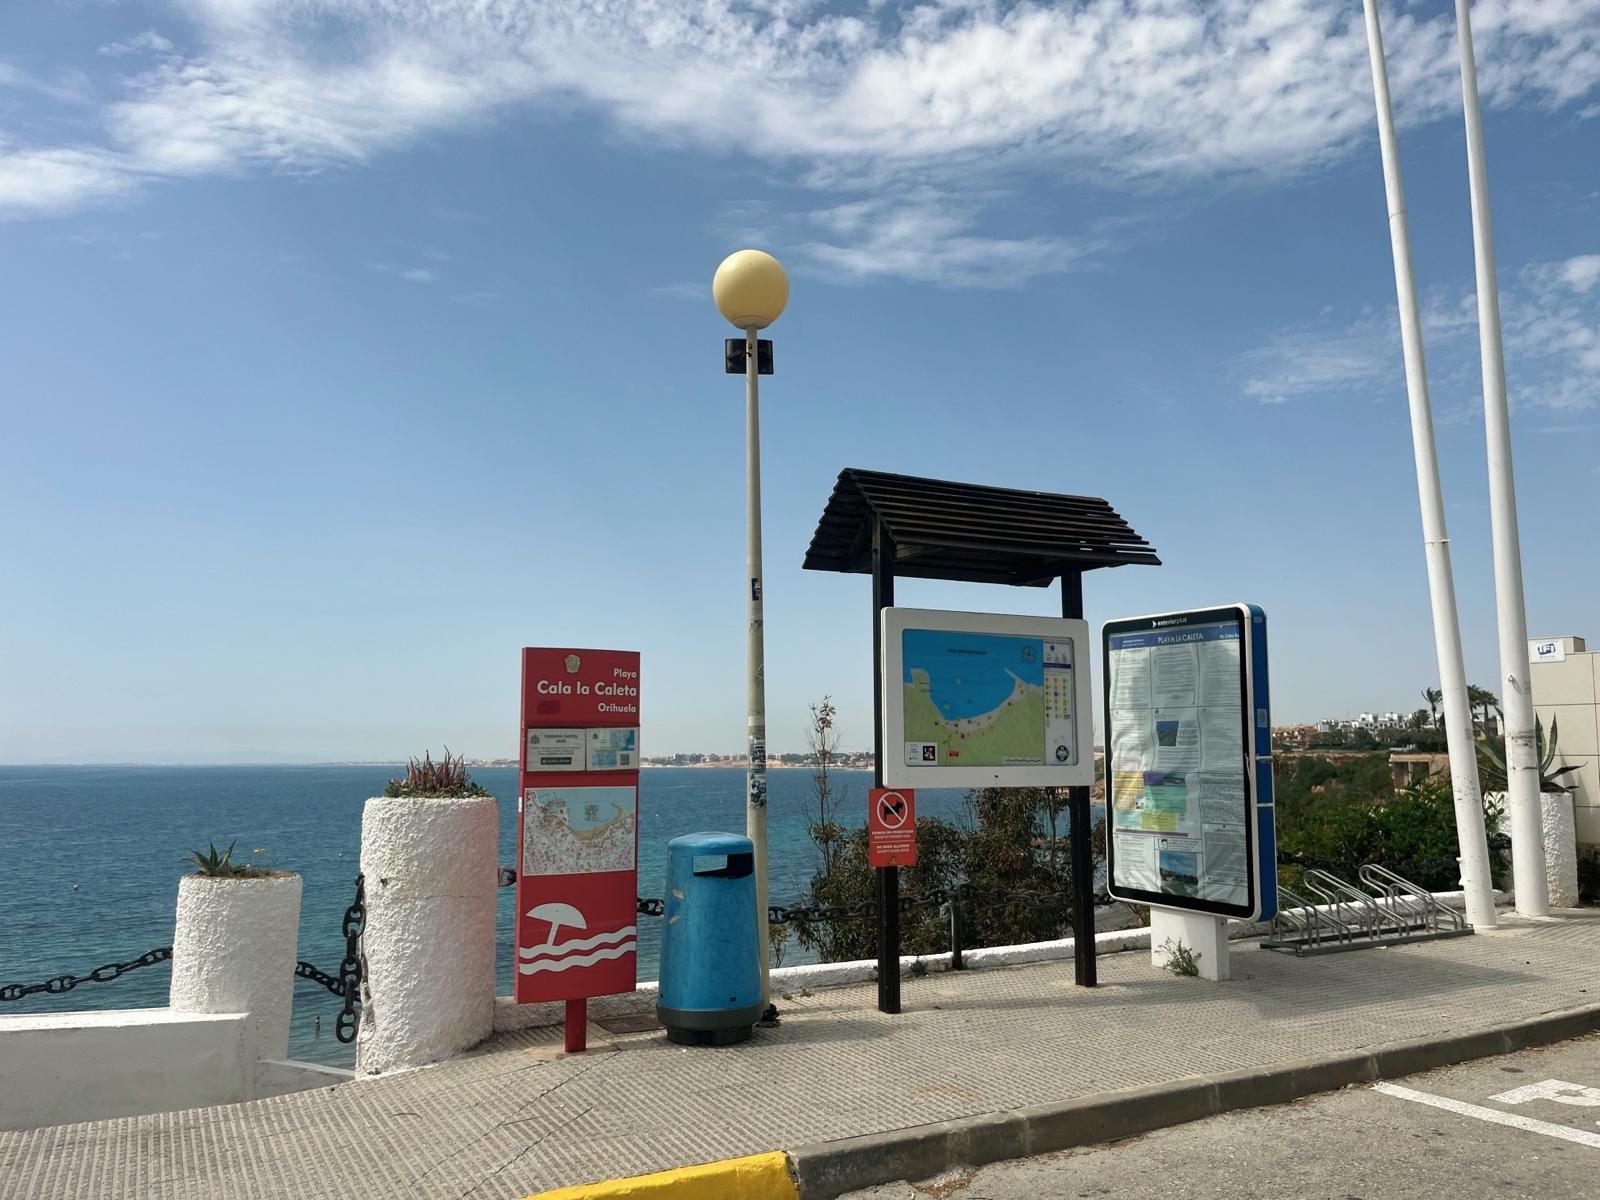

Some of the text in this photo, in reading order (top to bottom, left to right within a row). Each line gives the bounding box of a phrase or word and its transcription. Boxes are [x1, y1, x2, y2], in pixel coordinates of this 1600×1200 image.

[1157, 635, 1175, 644] PLAYA
[1182, 632, 1204, 641] CALETA
[614, 668, 637, 680] Playa
[537, 680, 637, 696] Cala la Caleta
[598, 702, 637, 713] Orihuela
